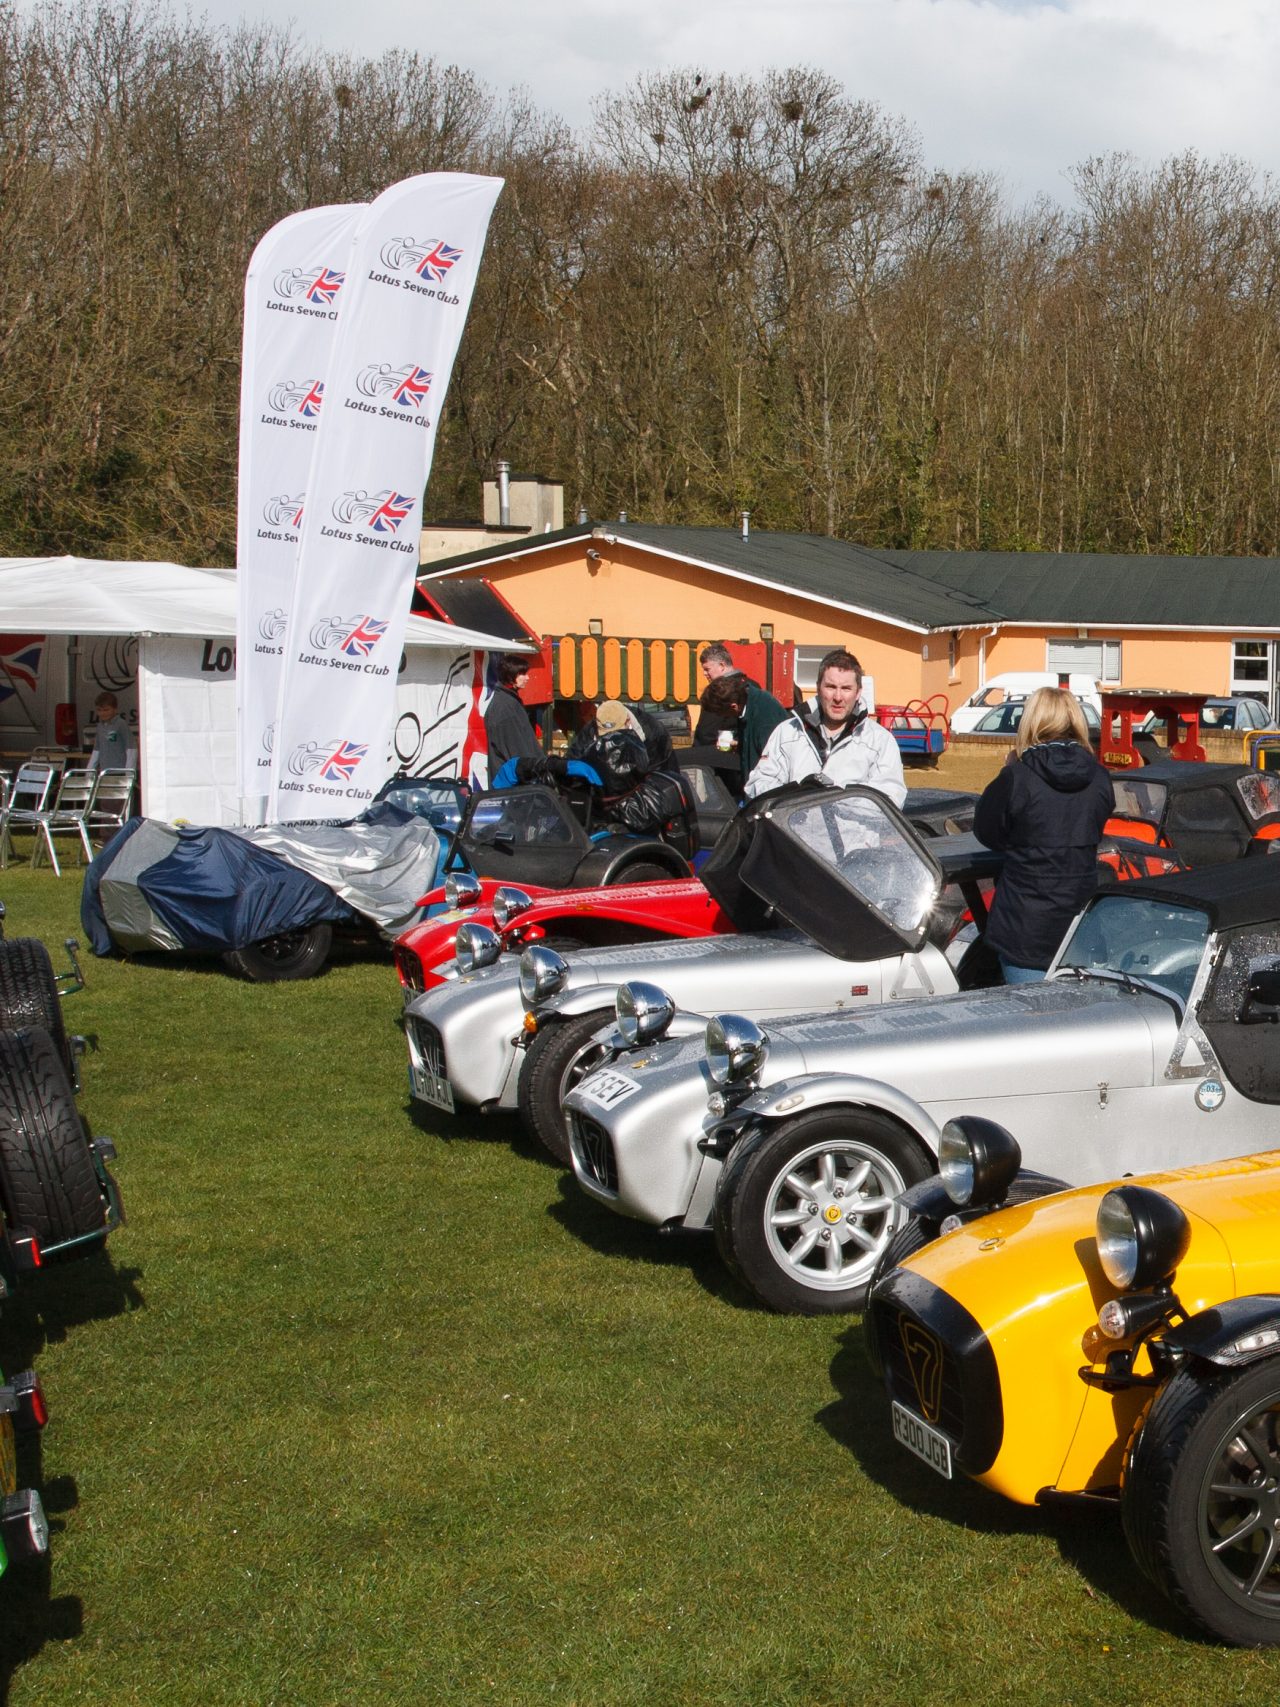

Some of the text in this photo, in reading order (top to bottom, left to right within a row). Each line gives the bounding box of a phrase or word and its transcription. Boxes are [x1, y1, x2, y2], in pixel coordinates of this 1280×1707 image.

[368, 270, 460, 306] Lotus Seven Club
[266, 300, 338, 321] Lotus Seven Cl
[261, 414, 288, 428] Lotus
[344, 398, 377, 415] Lotus
[379, 406, 413, 424] Seven
[257, 528, 298, 543] Lotus Sev
[320, 525, 415, 554] Lotus Seven Club
[254, 643, 276, 655] Lotus
[298, 652, 390, 676] Lotus Seven Club
[257, 757, 272, 767] Lot
[278, 779, 373, 800] Lotus Seven Club
[591, 1076, 635, 1103] SEV
